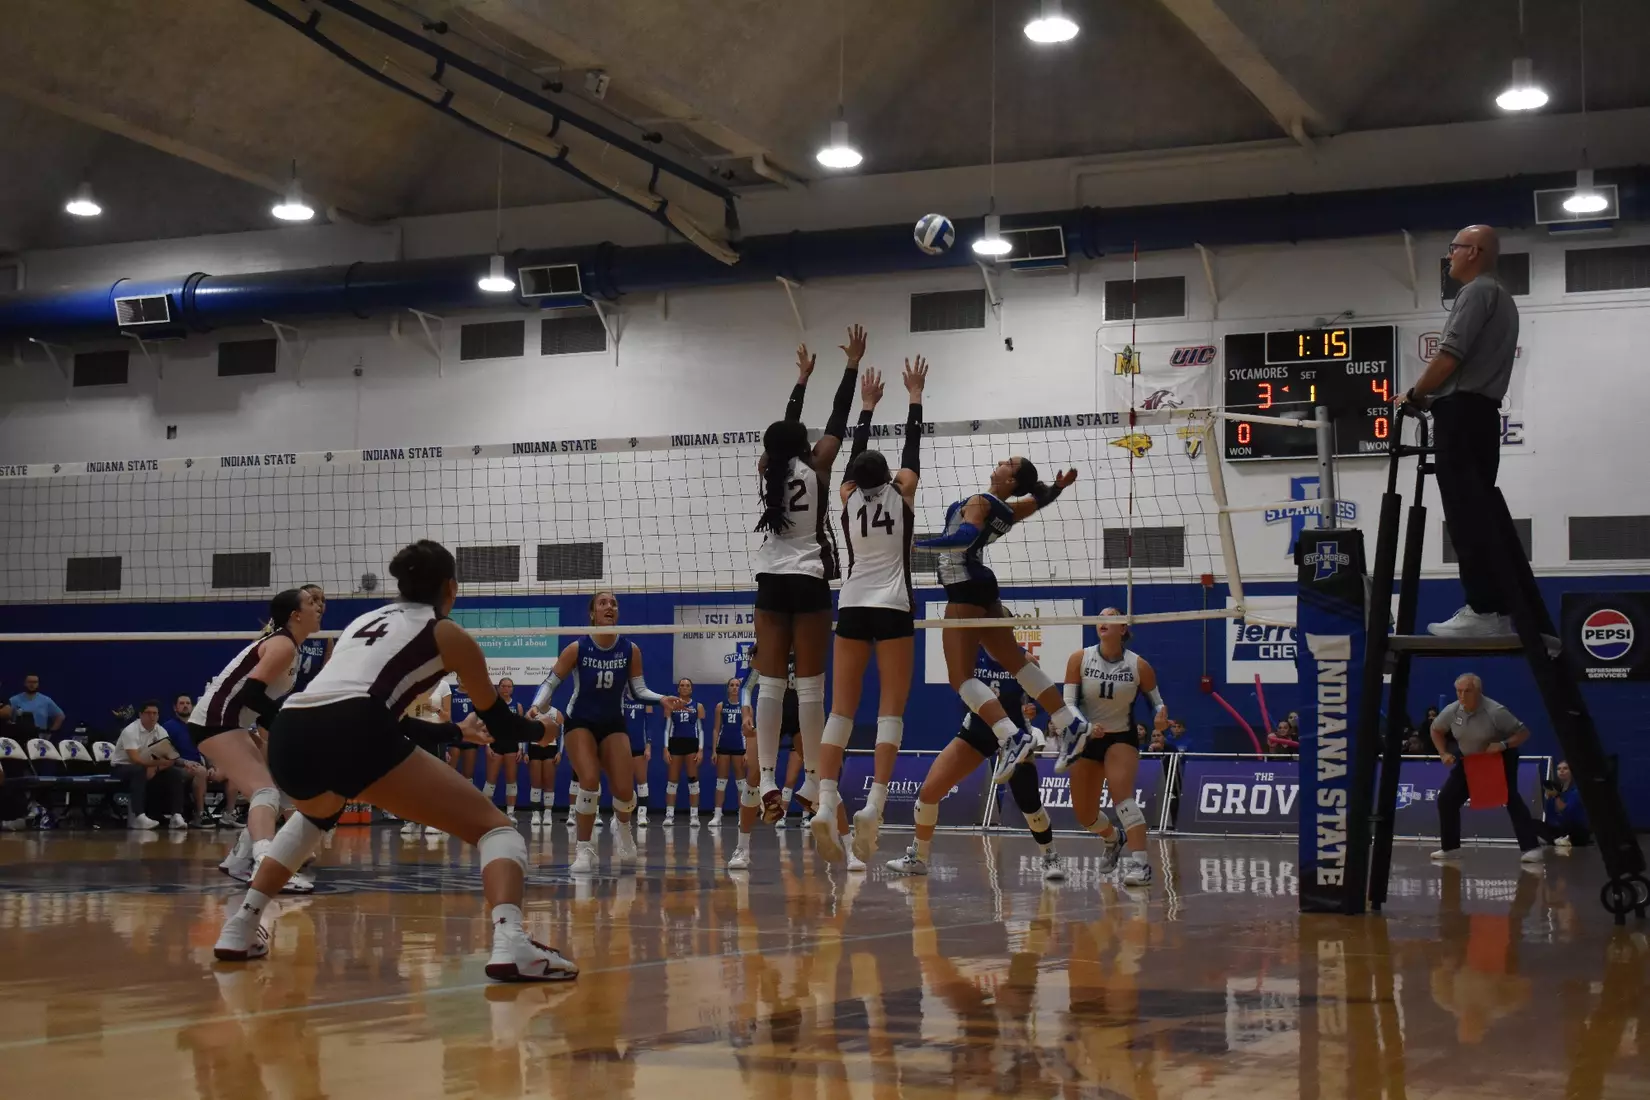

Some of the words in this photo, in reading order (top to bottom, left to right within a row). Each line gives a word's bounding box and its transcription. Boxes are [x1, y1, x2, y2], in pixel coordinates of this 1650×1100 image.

[1298, 331, 1348, 358] 1:15
[1170, 346, 1216, 366] UIC
[1229, 366, 1289, 381] SYCAMORES
[1300, 371, 1317, 380] SET
[1346, 361, 1387, 375] GUEST
[1257, 382, 1273, 409] 3
[1371, 378, 1389, 402] 4
[1366, 407, 1389, 416] SETS
[1018, 415, 1072, 429] INDIANA
[1076, 412, 1119, 426] STATE
[1374, 417, 1389, 439] 0
[894, 422, 934, 436] STTE
[1237, 422, 1251, 444] 0
[512, 440, 558, 454] INDIANA
[561, 439, 598, 452] STATE
[671, 432, 719, 447] INDIANA
[723, 431, 761, 444] STATE
[1366, 441, 1389, 451] WON
[362, 448, 405, 461] INDIANA
[408, 446, 443, 459] STATE
[1229, 447, 1252, 456] WON
[86, 461, 125, 472] INDIANA
[127, 459, 158, 471] STATE
[220, 455, 261, 467] INDIANA
[264, 454, 296, 465] STATE
[857, 503, 895, 538] 14
[1305, 553, 1349, 564] SYCAMORES
[352, 616, 389, 646] 4
[1584, 628, 1631, 640] PEPSI
[512, 638, 523, 647] all
[525, 638, 548, 647] about
[582, 656, 628, 670] SYCAMORES
[595, 670, 614, 689] 19
[1084, 667, 1134, 682] SYCAMORES
[1099, 681, 1113, 700] 11
[679, 712, 689, 722] 12
[1254, 772, 1274, 782] THE
[1199, 783, 1300, 815] GROV
[1316, 787, 1348, 887] STATE
